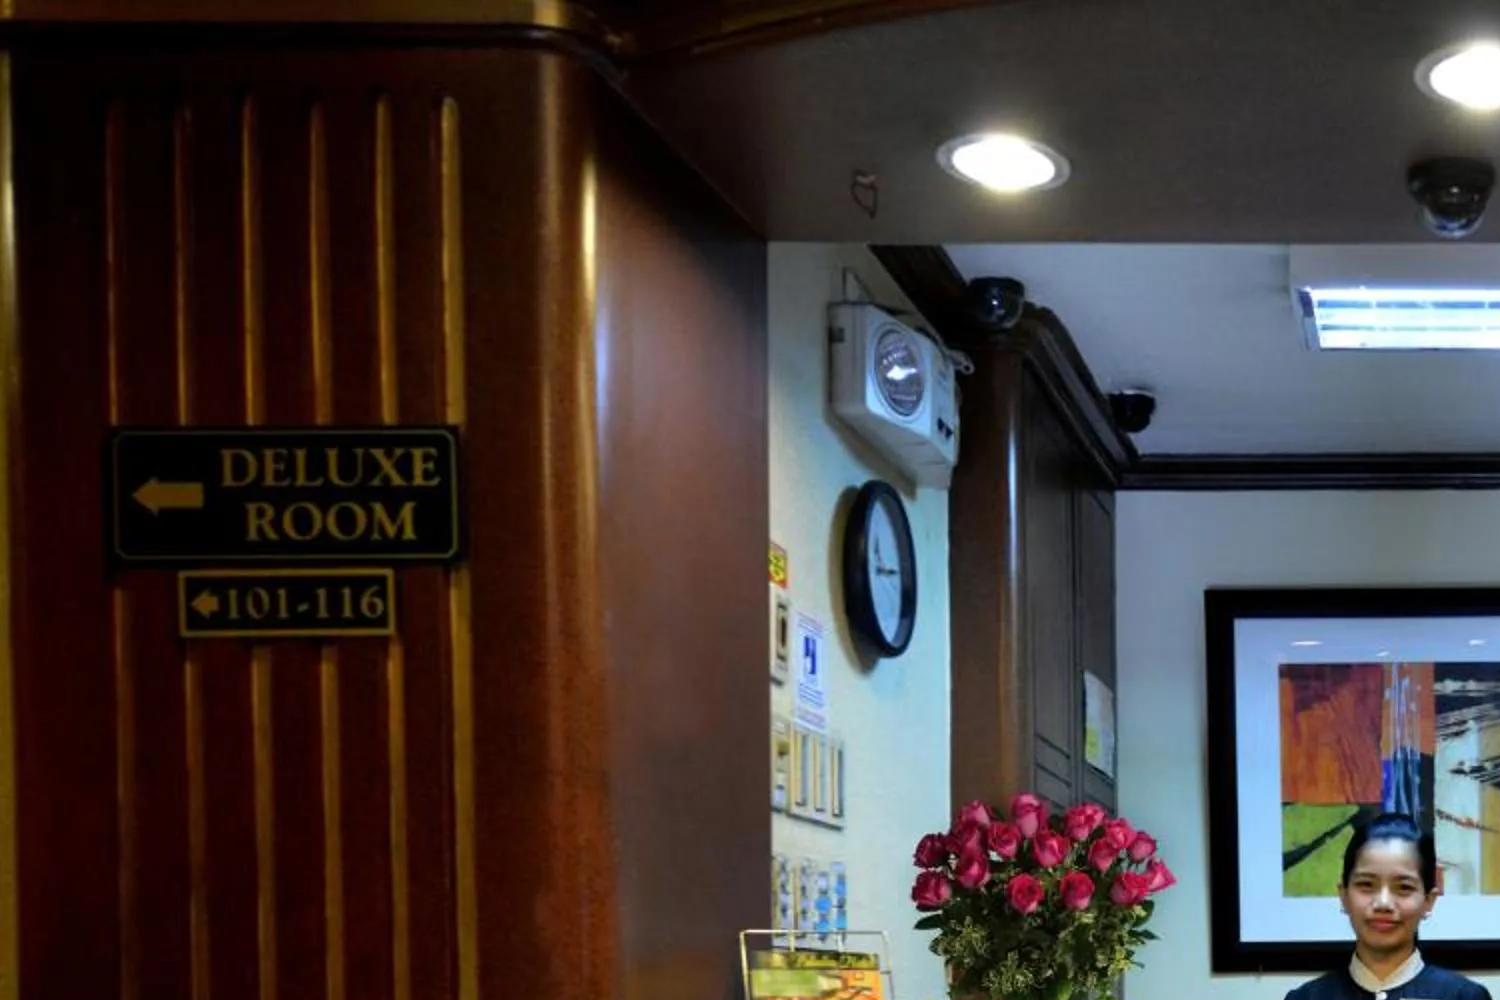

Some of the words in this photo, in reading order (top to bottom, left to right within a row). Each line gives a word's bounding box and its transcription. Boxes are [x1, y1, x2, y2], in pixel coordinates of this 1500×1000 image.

[220, 447, 441, 488] DELUXE
[245, 501, 418, 541] ROOM
[226, 585, 385, 620] 101-116
